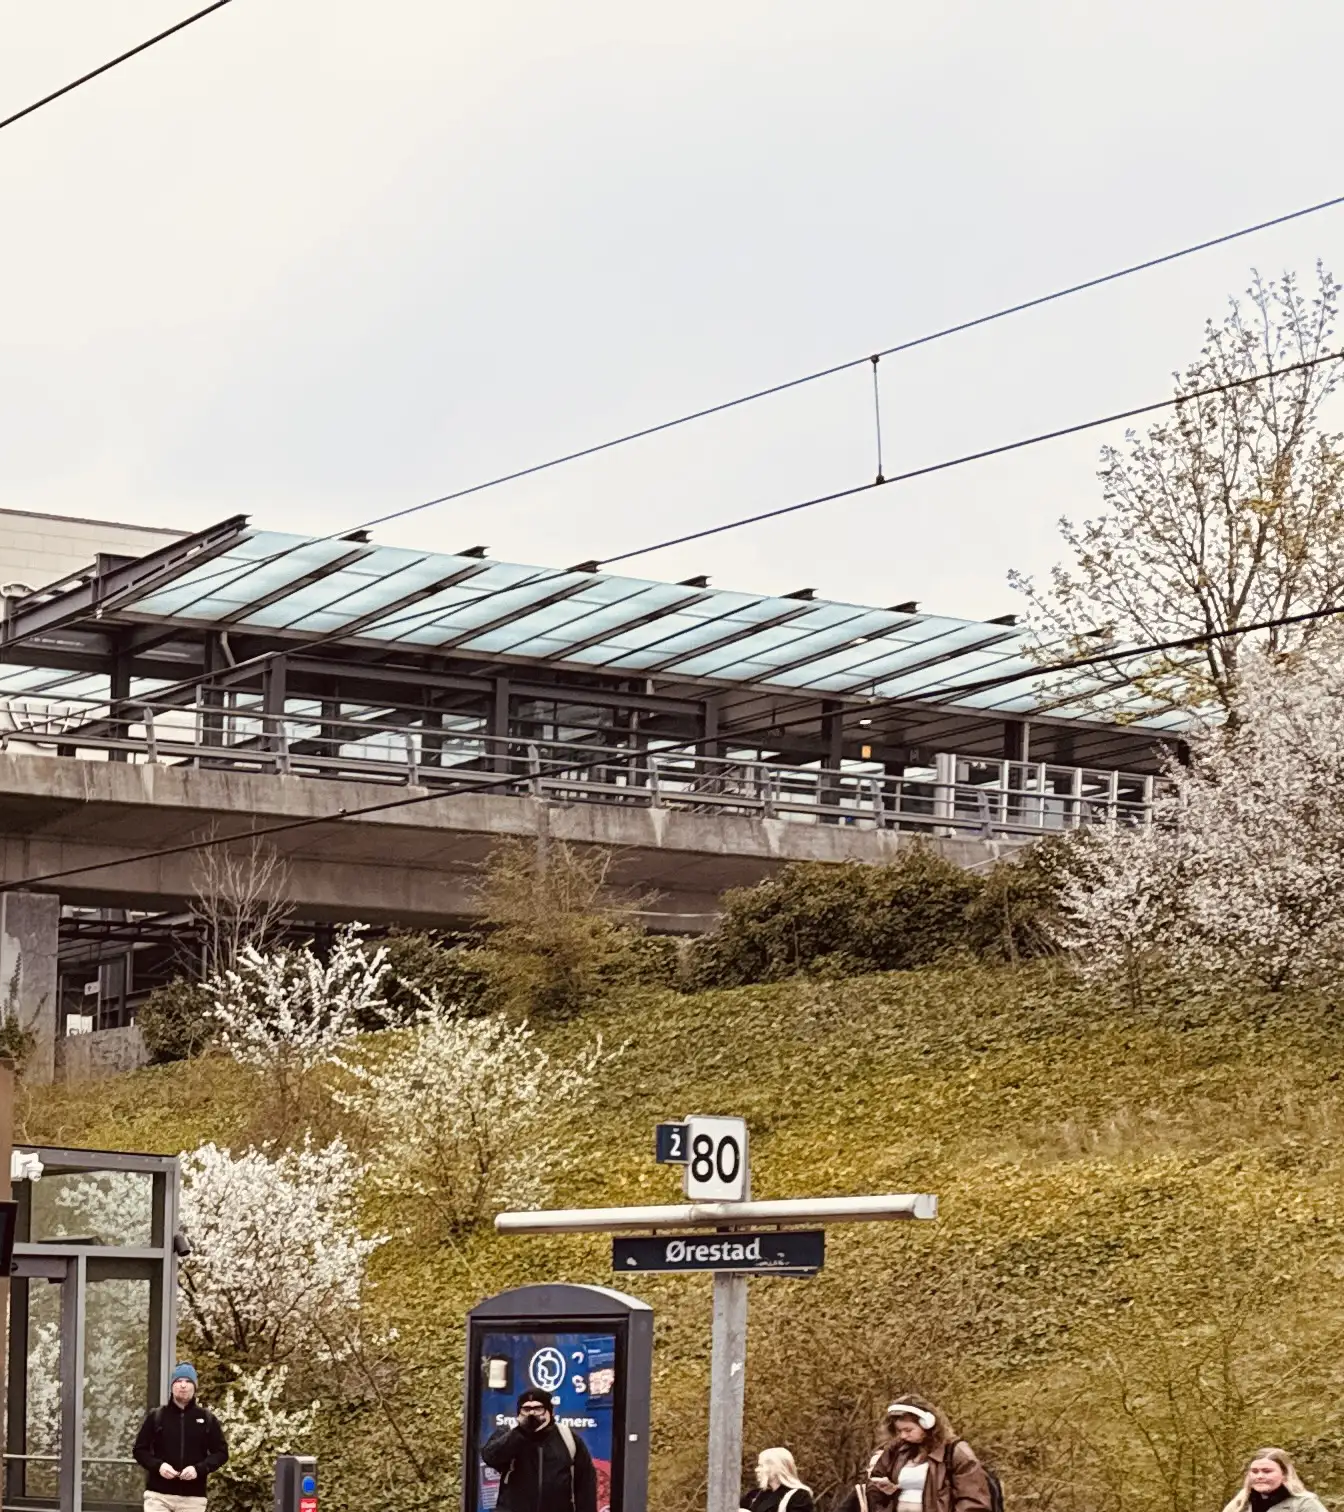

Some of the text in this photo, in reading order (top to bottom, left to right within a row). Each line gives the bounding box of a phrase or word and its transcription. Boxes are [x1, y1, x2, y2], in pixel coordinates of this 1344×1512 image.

[670, 1133, 681, 1156] 2
[691, 1134, 740, 1183] 80
[665, 1237, 761, 1262] Ørestad
